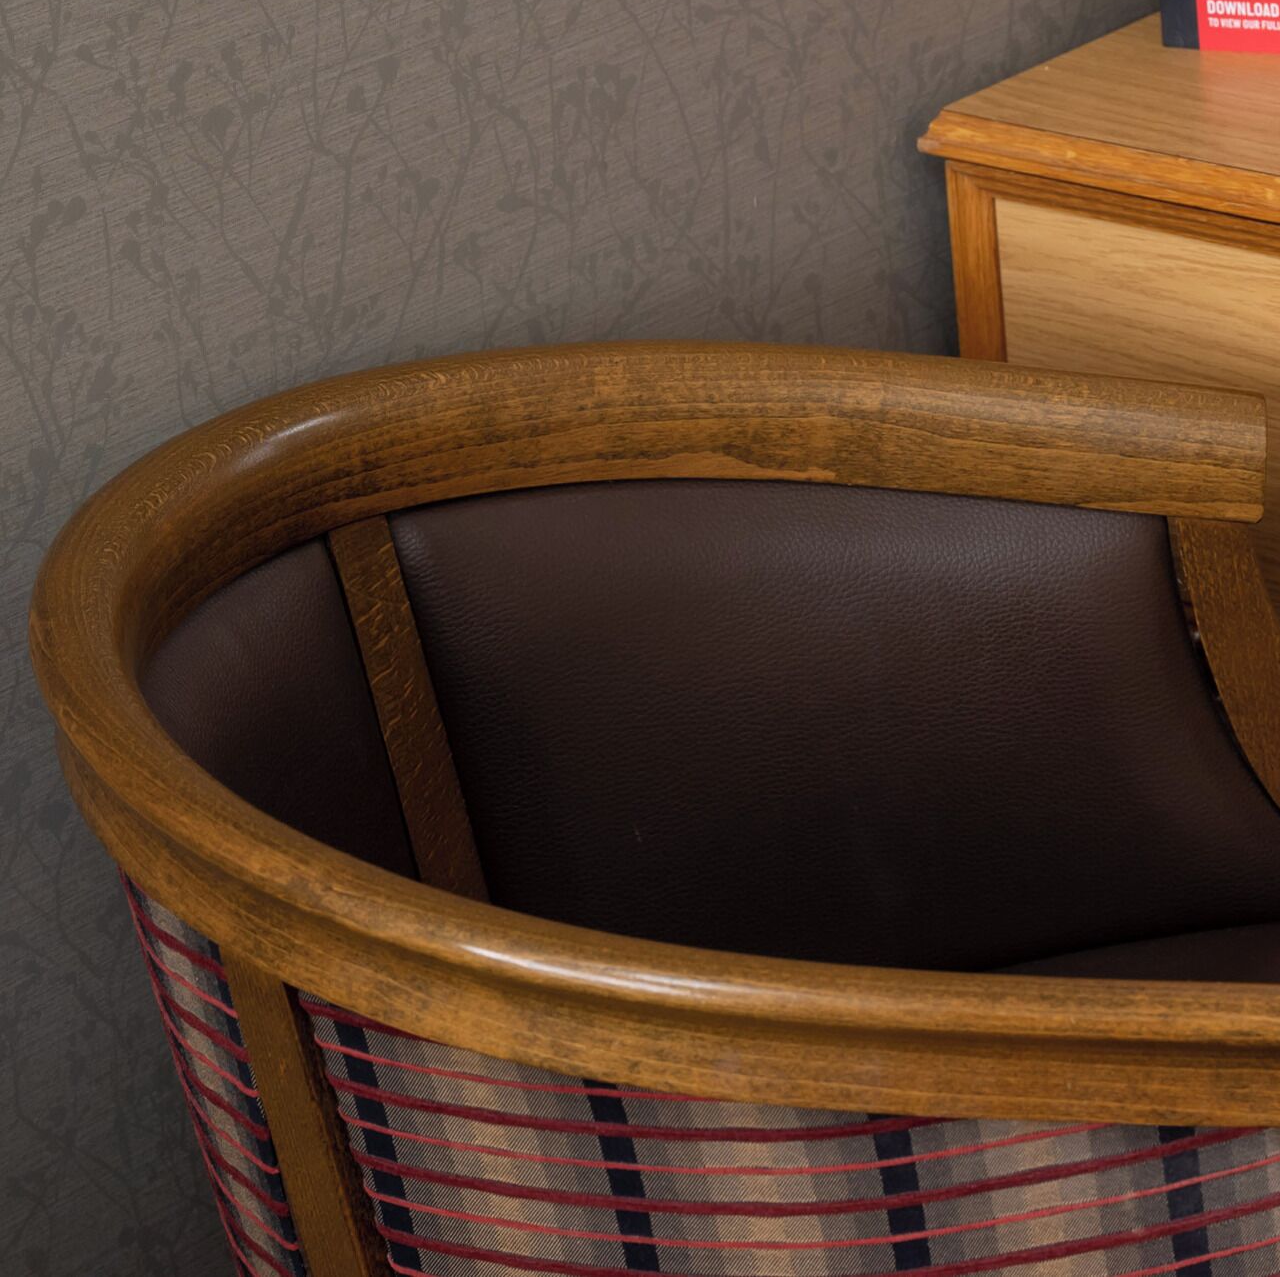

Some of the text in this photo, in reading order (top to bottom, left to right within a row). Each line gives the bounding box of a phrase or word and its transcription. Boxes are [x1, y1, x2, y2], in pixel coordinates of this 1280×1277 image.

[1206, 0, 1280, 18] DOWNLOAD
[1208, 17, 1219, 28] TO
[1221, 18, 1241, 28] VIEW
[1242, 19, 1260, 29] OUR
